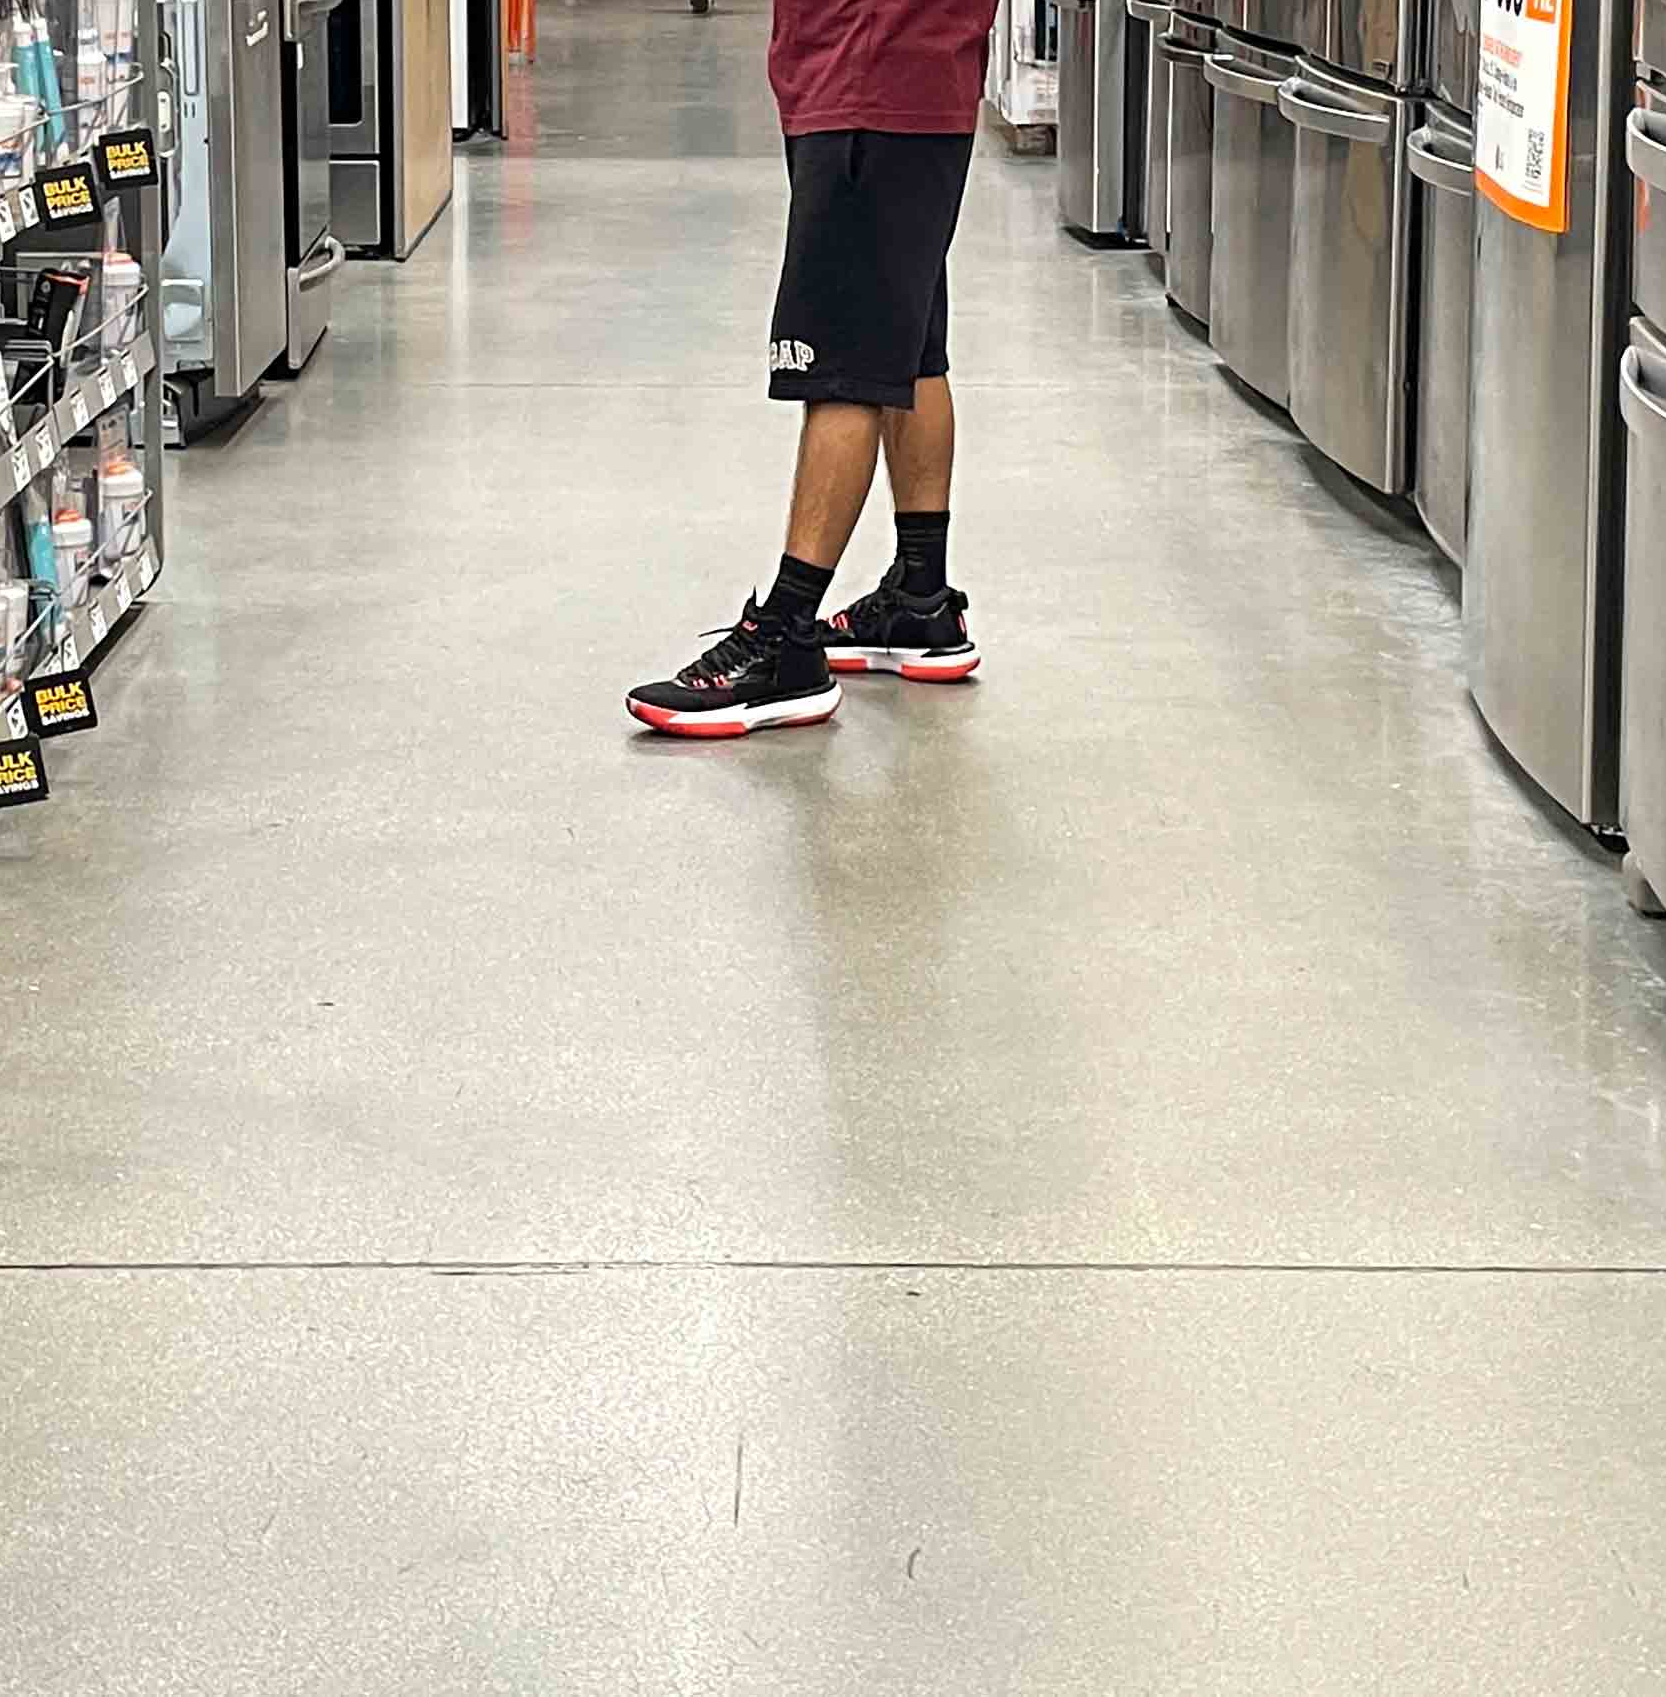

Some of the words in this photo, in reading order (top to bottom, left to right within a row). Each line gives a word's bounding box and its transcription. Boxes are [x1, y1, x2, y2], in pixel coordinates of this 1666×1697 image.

[105, 141, 146, 159] BULK
[107, 153, 149, 172] PRICE
[43, 175, 88, 198] BULK
[46, 186, 92, 209] PRICE
[36, 682, 84, 704] BULK
[38, 694, 87, 716] PRICE
[41, 709, 90, 726] SAVINGS
